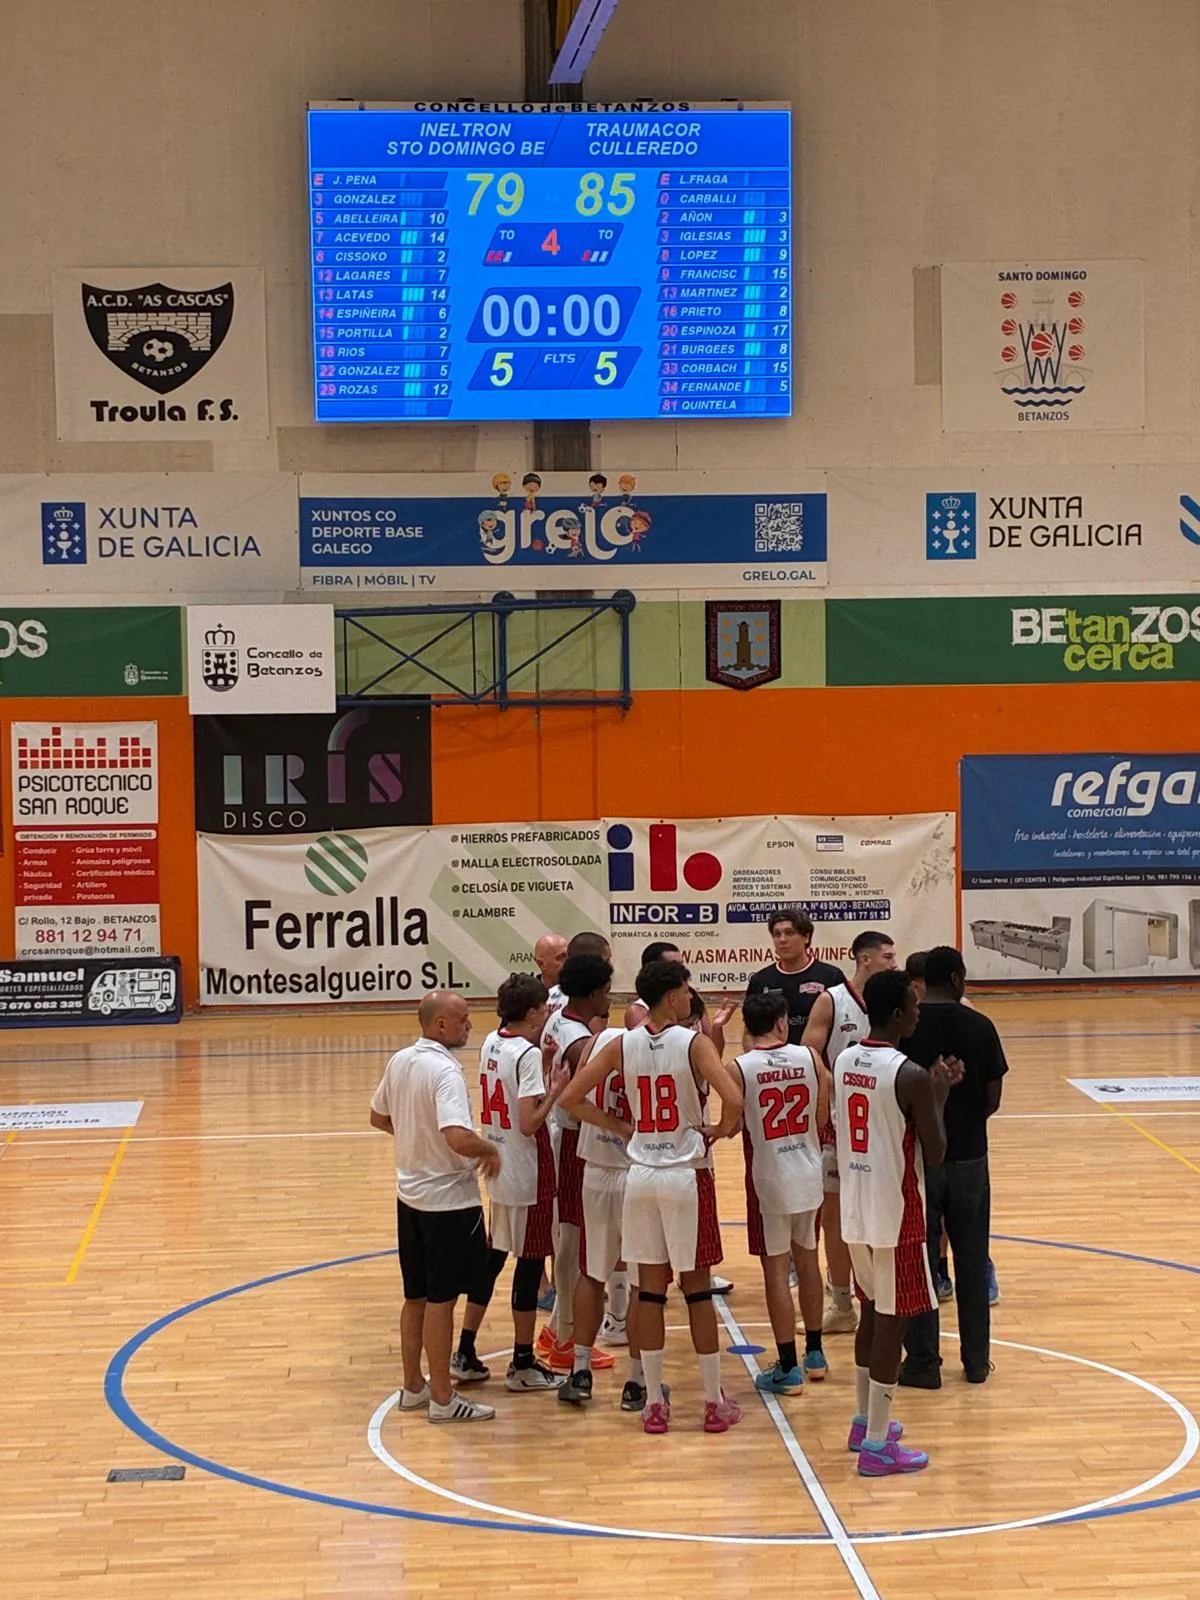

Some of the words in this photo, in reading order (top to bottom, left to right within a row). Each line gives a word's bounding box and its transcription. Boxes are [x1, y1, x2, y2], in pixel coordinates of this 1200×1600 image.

[414, 102, 534, 113] CONCELLO
[541, 102, 565, 113] de
[571, 101, 690, 113] BETANZOS
[420, 122, 512, 137] INELTRON
[586, 122, 701, 137] TRAUMACOR
[387, 141, 423, 155] STO
[428, 141, 515, 155] DOMINGO
[520, 141, 545, 155] BE
[589, 141, 698, 155] CULLEREDO
[346, 176, 377, 185] PENA
[679, 175, 728, 185] L.FRAGA
[334, 194, 396, 204] GONZALEZ
[466, 172, 525, 216] 79
[575, 172, 636, 216] 85
[680, 194, 736, 204] CARBALLI
[334, 214, 398, 224] ABELLEIRA
[430, 213, 445, 224] 10
[680, 211, 712, 222] AÑON
[779, 211, 787, 222] 3
[334, 233, 391, 243] ACEVEDO
[430, 232, 445, 243] 14
[499, 230, 515, 240] TO
[598, 230, 613, 240] TO
[680, 231, 731, 241] IGLESIAS
[779, 230, 787, 241] 3
[541, 229, 560, 256] 4
[335, 252, 387, 262] CISSOKO
[437, 251, 446, 262] 2
[680, 250, 718, 260] LOPEZ
[779, 249, 787, 260] 9
[336, 271, 390, 281] LAGARES
[438, 270, 447, 281] 7
[680, 269, 737, 279] FRANCISC
[772, 268, 787, 279] 15
[998, 271, 1033, 281] SANTO
[1036, 271, 1087, 281] DOMINGO
[336, 290, 374, 300] LATAS
[431, 289, 446, 300] 14
[680, 288, 738, 298] MARTINEZ
[779, 287, 788, 298] 2
[87, 295, 132, 307] A.C.D.
[138, 294, 162, 307] "AS
[167, 294, 228, 307] CASCAS"
[336, 307, 397, 319] ESPIÑEIRA
[438, 308, 447, 319] 6
[483, 294, 620, 337] 00:00
[680, 307, 721, 317] PRIETO
[779, 306, 787, 316] 8
[337, 328, 393, 338] PORTILLA
[439, 328, 448, 339] 2
[680, 326, 736, 336] ESPINOZA
[773, 325, 788, 336] 17
[337, 347, 365, 357] RIOS
[439, 346, 448, 357] 7
[681, 344, 735, 354] BURGEES
[779, 343, 787, 354] 8
[543, 353, 576, 363] FLTS
[131, 362, 188, 377] BETANZOS
[338, 366, 400, 376] GONZALEZ
[440, 365, 448, 377] 5
[490, 352, 513, 387] 5
[594, 351, 618, 386] 5
[681, 363, 737, 373] CORBACH
[772, 362, 788, 373] 15
[338, 385, 378, 395] ROZAS
[432, 383, 448, 395] 12
[681, 382, 742, 392] FERNANDE
[779, 380, 788, 392] 5
[90, 400, 186, 422] Troula
[681, 400, 737, 410] QUINTELA
[1018, 412, 1069, 421] BETANZOS
[989, 496, 1083, 519] XUNTA
[99, 507, 198, 529] XUNTA
[311, 511, 371, 522] XUNTOS
[375, 511, 396, 522] CO
[312, 526, 381, 538] DEPORTE
[385, 526, 424, 538] BASE
[480, 507, 642, 565] grelo
[988, 526, 1022, 548] DE
[1030, 524, 1143, 547] GALICIA
[99, 536, 135, 557] DE
[143, 535, 261, 557] GALICIA
[312, 543, 372, 555] GALEGO
[312, 575, 353, 586] FIBRA
[364, 572, 408, 586] MÓBIL
[419, 575, 436, 585] TV
[742, 570, 816, 581] GRELO.GAL
[247, 647, 304, 659] Concello
[309, 650, 323, 659] de
[1063, 642, 1174, 672] cerca
[247, 663, 323, 678] Betanzos
[18, 774, 152, 792] PSICOTECNICO
[1051, 761, 1200, 816] refga
[19, 798, 57, 815] SAN
[66, 797, 129, 817] ROQUE
[1067, 806, 1127, 818] comercial
[224, 811, 307, 829] DISCO
[461, 833, 508, 844] HIERROS
[511, 830, 600, 842] PREFABRICADOS
[1032, 829, 1067, 840] industrial
[461, 858, 499, 868] MALLA
[502, 855, 602, 868] ELECTROSOLDADA
[607, 824, 722, 892] ilo
[24, 882, 62, 890] Seguridad
[461, 880, 508, 893] CELOSÍA
[511, 882, 525, 892] DE
[528, 881, 574, 891] VIGUETA
[828, 901, 847, 910] BAJO
[852, 901, 889, 909] BETANZOS
[462, 907, 516, 918] ALAMBRE
[613, 905, 679, 922] INFOR
[699, 905, 713, 922] B
[18, 917, 29, 926] C/
[31, 917, 58, 926] Rollo,
[61, 916, 71, 924] 12
[74, 916, 96, 926] Bajo
[103, 915, 157, 924] BETANZOS
[245, 896, 430, 950] Ferralla
[35, 929, 65, 944] 881
[72, 929, 92, 943] 12
[97, 928, 118, 942] 94
[123, 928, 142, 942] 71
[21, 945, 155, 956] crcsanroque@hotmail.com
[0, 968, 85, 983] Samuel
[206, 963, 412, 1000] Montesalgueiro
[421, 961, 470, 990] S.L.
[24, 984, 84, 992] ESPECIALIZADOS
[9, 1002, 32, 1010] 676
[34, 1001, 58, 1009] 082
[843, 1072, 877, 1090] CISSOKO
[480, 1074, 511, 1129] 14
[637, 1075, 679, 1133] 18
[759, 1083, 810, 1141] 22
[848, 1092, 869, 1153] 8
